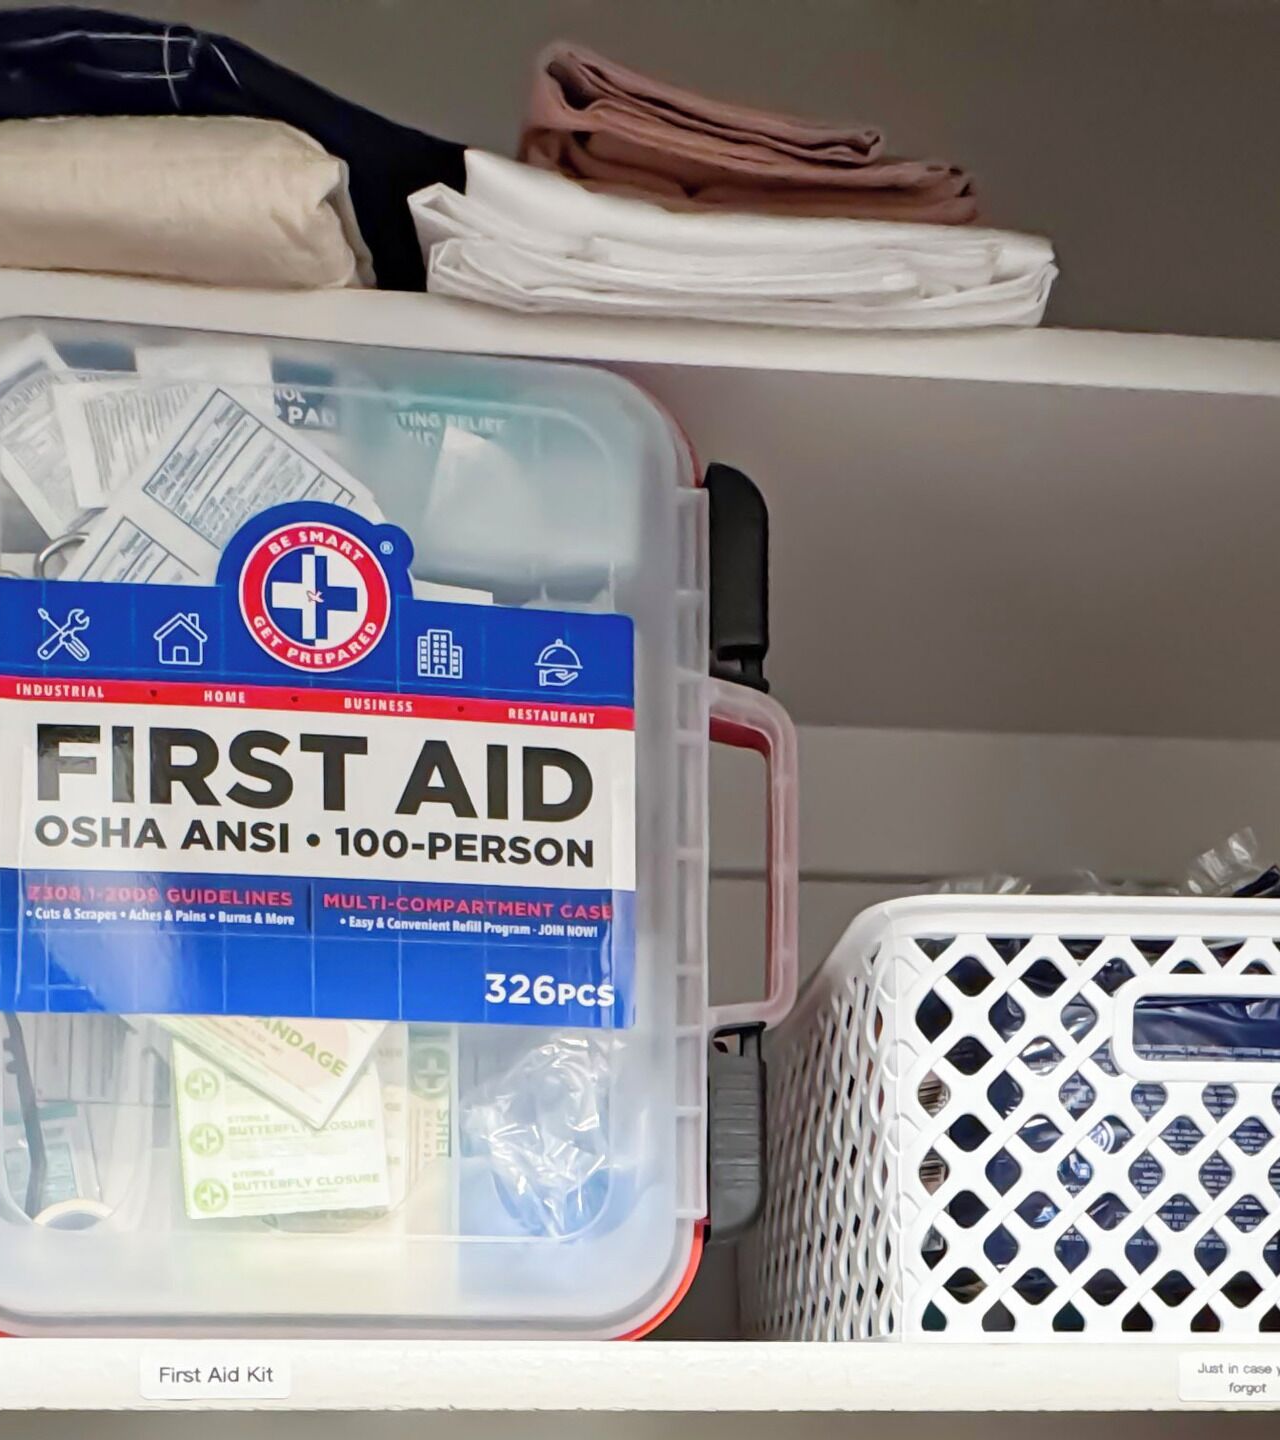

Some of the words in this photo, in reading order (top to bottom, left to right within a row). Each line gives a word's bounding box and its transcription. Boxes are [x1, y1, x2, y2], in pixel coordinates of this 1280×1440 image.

[268, 535, 292, 555] BE
[299, 530, 364, 562] SMART
[253, 615, 282, 648] GET
[286, 622, 377, 664] PREPARED
[16, 683, 105, 699] INDUSTRIAL
[204, 690, 246, 704] HOME
[343, 697, 414, 713] BUSINESS
[508, 708, 596, 725] RESTAURANT
[35, 723, 368, 812] FIRST
[394, 739, 594, 823] AID
[34, 814, 167, 851] OSHA
[181, 819, 290, 854] ANSI
[335, 827, 595, 869] 100-PERSON
[166, 887, 294, 907] GUIDELINES
[323, 893, 554, 918] MULTI-COMPARTMENT
[560, 904, 613, 921] CASE
[35, 908, 61, 920] Cuts
[63, 909, 71, 920] &
[73, 909, 117, 923] Scrapes
[129, 909, 162, 922] Aches
[164, 910, 173, 922] &
[175, 910, 207, 923] Pains
[218, 911, 252, 924] Burns
[254, 912, 263, 925] &
[265, 912, 295, 926] More
[349, 916, 374, 931] Easy
[376, 917, 385, 929] &
[387, 917, 451, 932] Convenient
[452, 920, 482, 933] Refill
[484, 921, 531, 938] Program
[537, 923, 565, 937] JOIN
[566, 925, 598, 938] NOW!
[484, 972, 616, 1007] 326PCS
[255, 1017, 349, 1078] ANDAGE
[233, 1175, 312, 1191] BUTTERFLY
[317, 1172, 380, 1187] CLOSURE
[159, 1366, 202, 1383] First
[208, 1366, 240, 1383] Aid
[247, 1366, 273, 1383] Kit
[1198, 1363, 1224, 1375] Just
[1228, 1363, 1239, 1375] in
[1243, 1365, 1272, 1375] case
[1229, 1382, 1267, 1396] forgot
